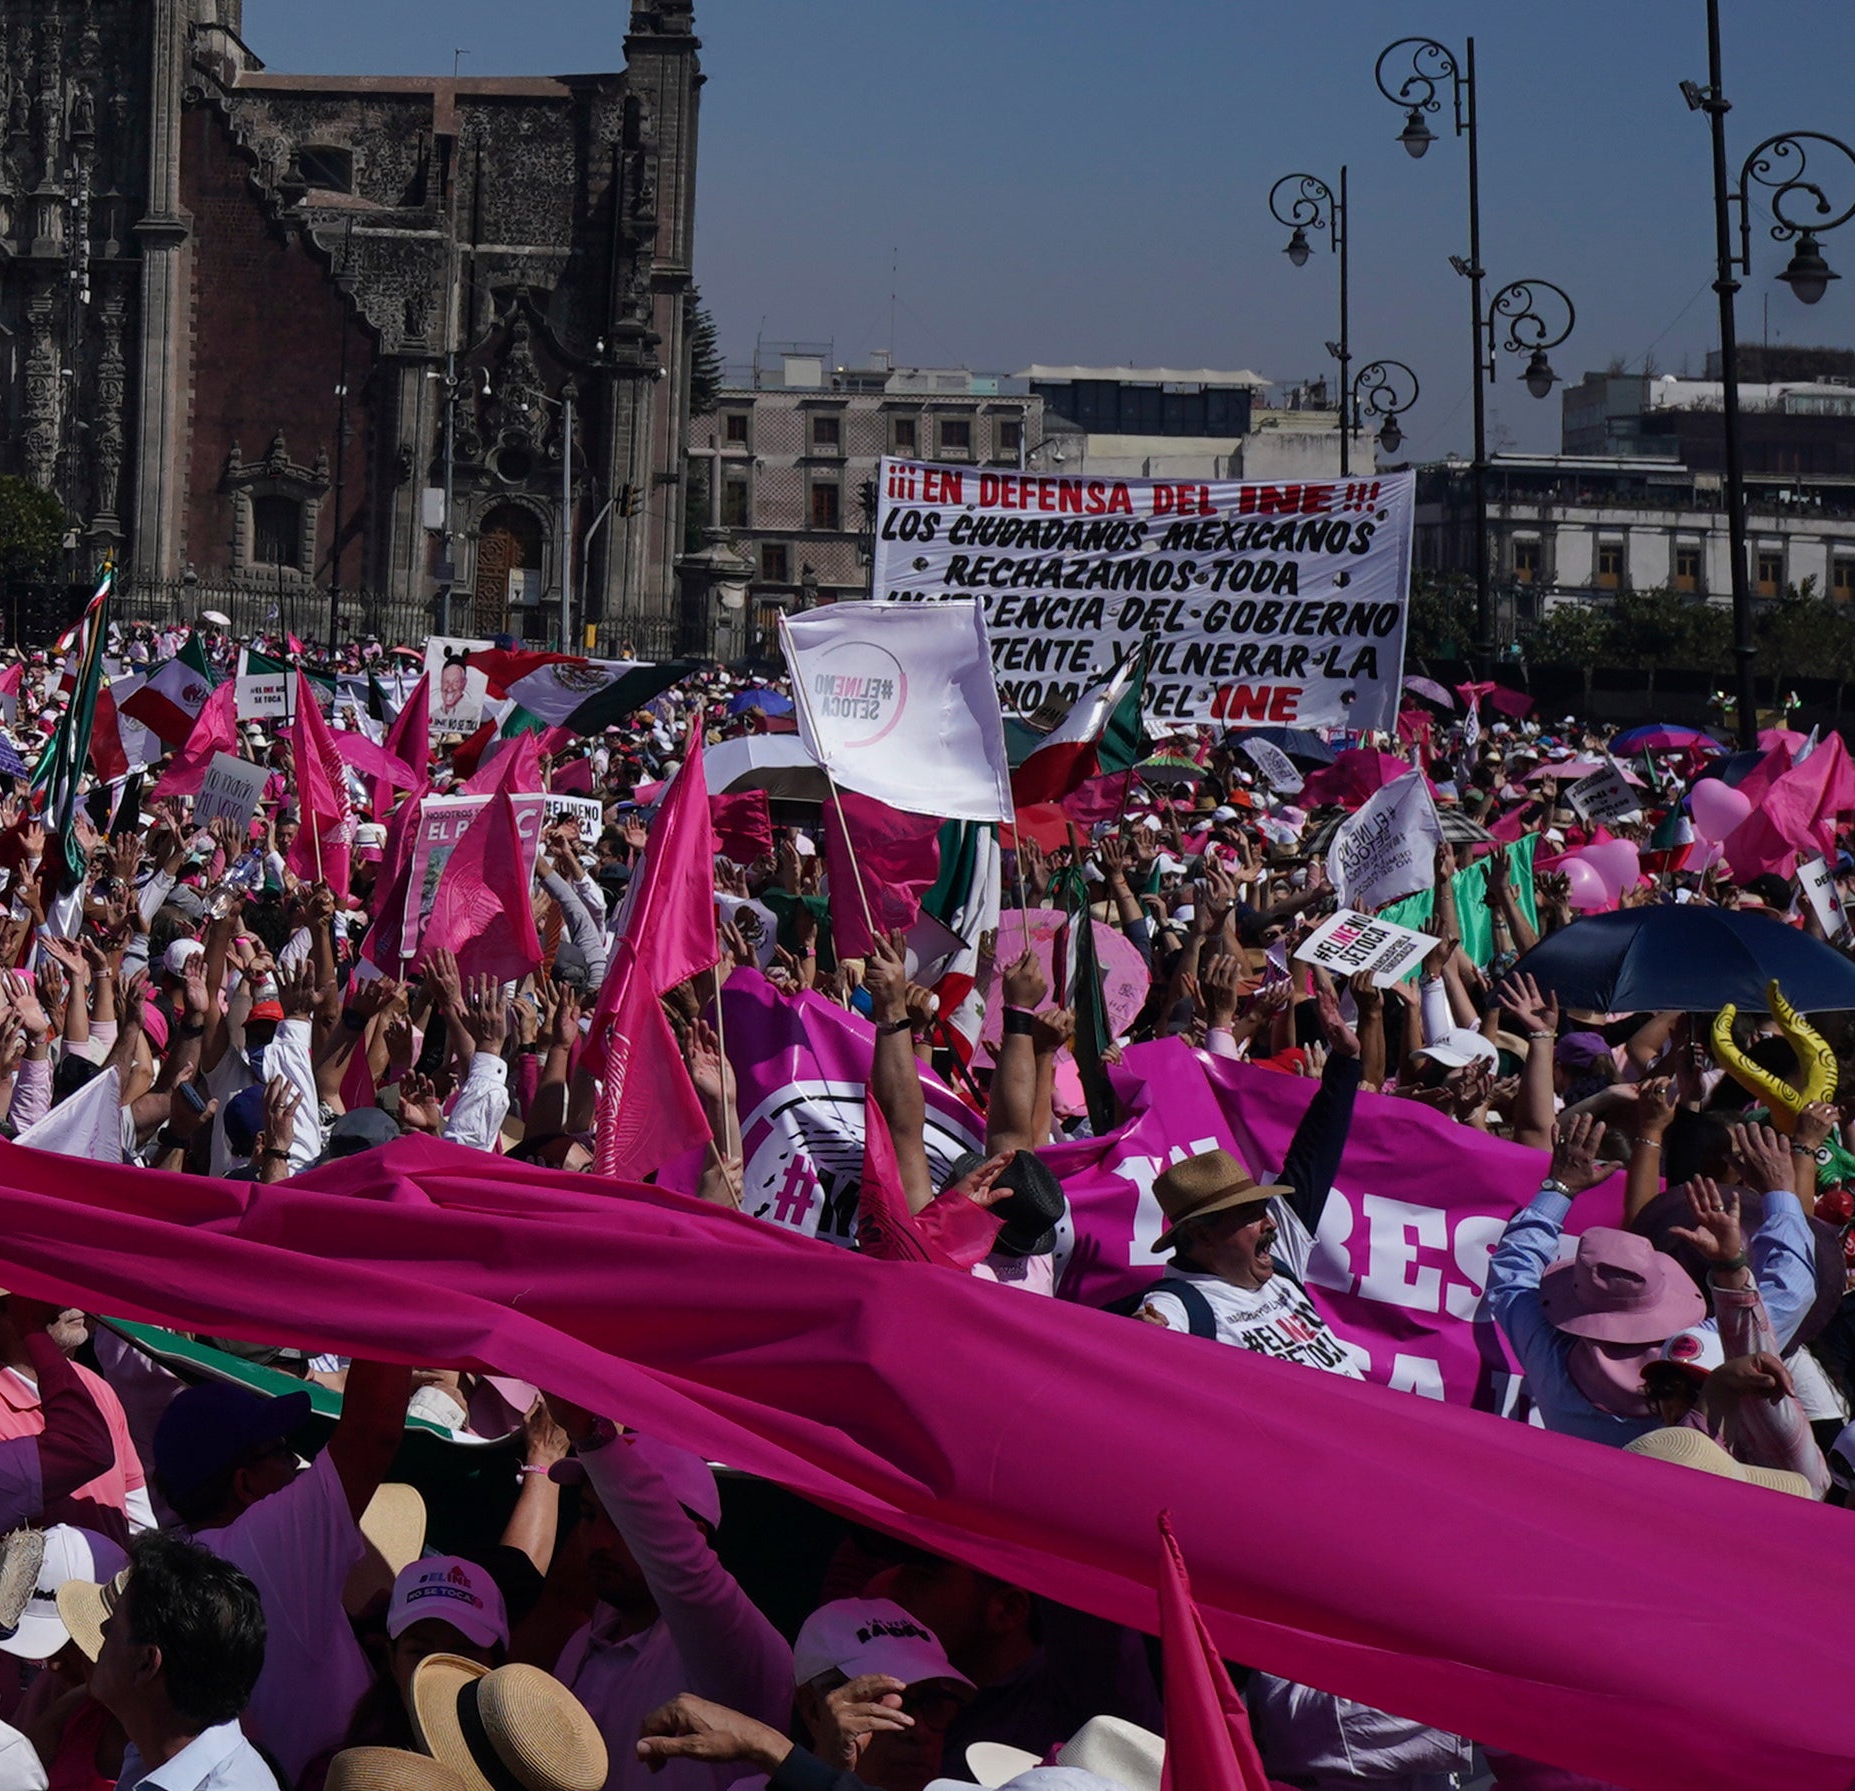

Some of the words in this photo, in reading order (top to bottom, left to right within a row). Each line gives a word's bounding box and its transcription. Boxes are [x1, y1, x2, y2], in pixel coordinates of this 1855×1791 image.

[979, 472, 1134, 514] DEFENSA
[1153, 483, 1218, 515] DEL
[881, 506, 942, 543] LOS
[948, 514, 1149, 552] CIUDADANOS
[1160, 519, 1376, 555] MEXICANOS
[943, 554, 1196, 592] RECHAZAMOS
[1210, 559, 1299, 596] TODA
[1117, 597, 1186, 633] DEL
[1204, 599, 1399, 638] GOBIERNO
[1321, 645, 1379, 680] LA
[1209, 684, 1304, 723] INE
[427, 824, 450, 841] EL
[1313, 913, 1374, 962] #ELINENO
[1338, 924, 1391, 966] SETOCA
[408, 1591, 423, 1601] NO
[424, 1589, 438, 1597] SE
